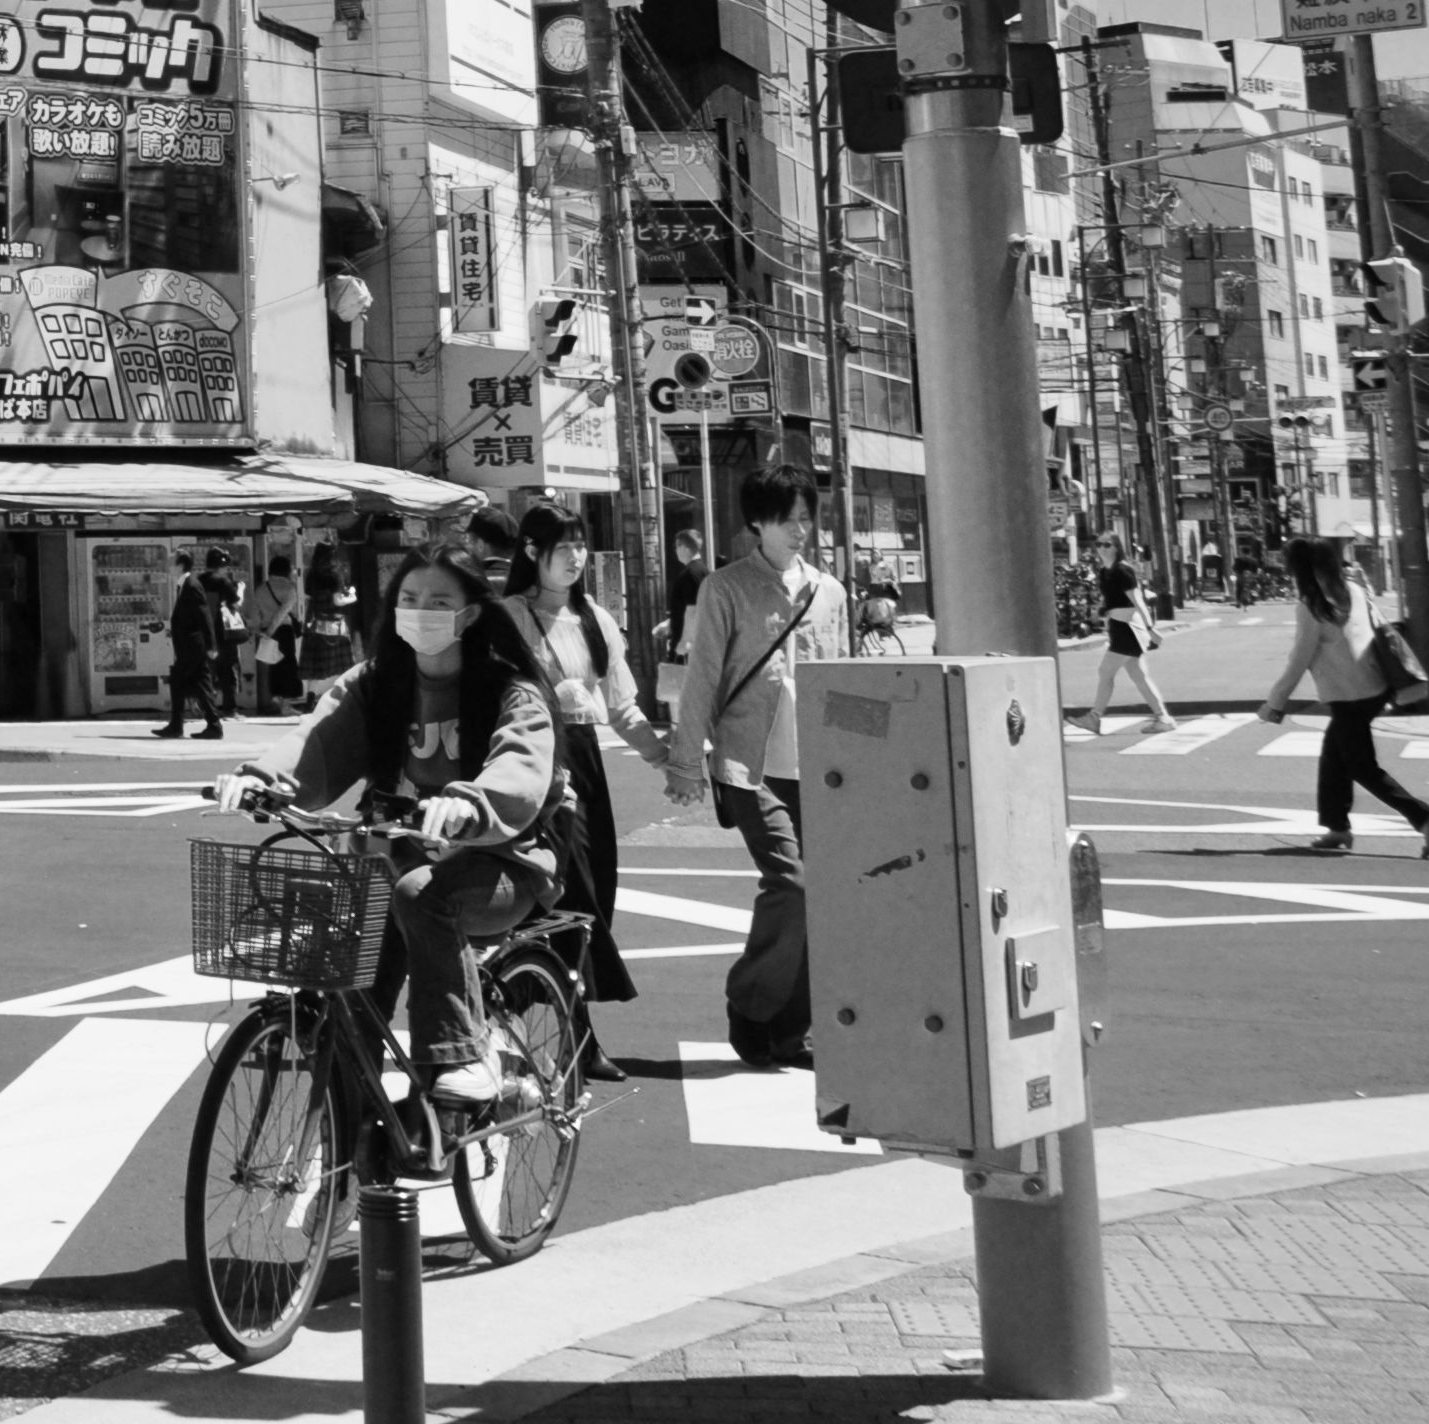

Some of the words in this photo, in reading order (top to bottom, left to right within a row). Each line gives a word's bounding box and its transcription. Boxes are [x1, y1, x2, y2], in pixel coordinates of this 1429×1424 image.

[1290, 12, 1348, 32] Namba
[1356, 7, 1397, 25] naka
[1406, 3, 1417, 20] 2
[37, 13, 216, 84] コミック
[31, 99, 123, 126] カラオケも
[138, 104, 234, 132] コミック5万冊
[31, 127, 115, 157] 歌い放題!
[139, 131, 223, 162] 読み放題
[458, 211, 483, 303] 賃貸住宅
[139, 270, 225, 320] すぐそこ
[659, 296, 682, 309] Get
[114, 327, 148, 341] ダイソー
[157, 327, 191, 341] とんかつ
[661, 326, 691, 339] Gam
[661, 340, 692, 353] Oasi
[713, 339, 755, 360] 消火栓
[468, 375, 533, 411] 賃貸
[473, 434, 535, 467] 売買
